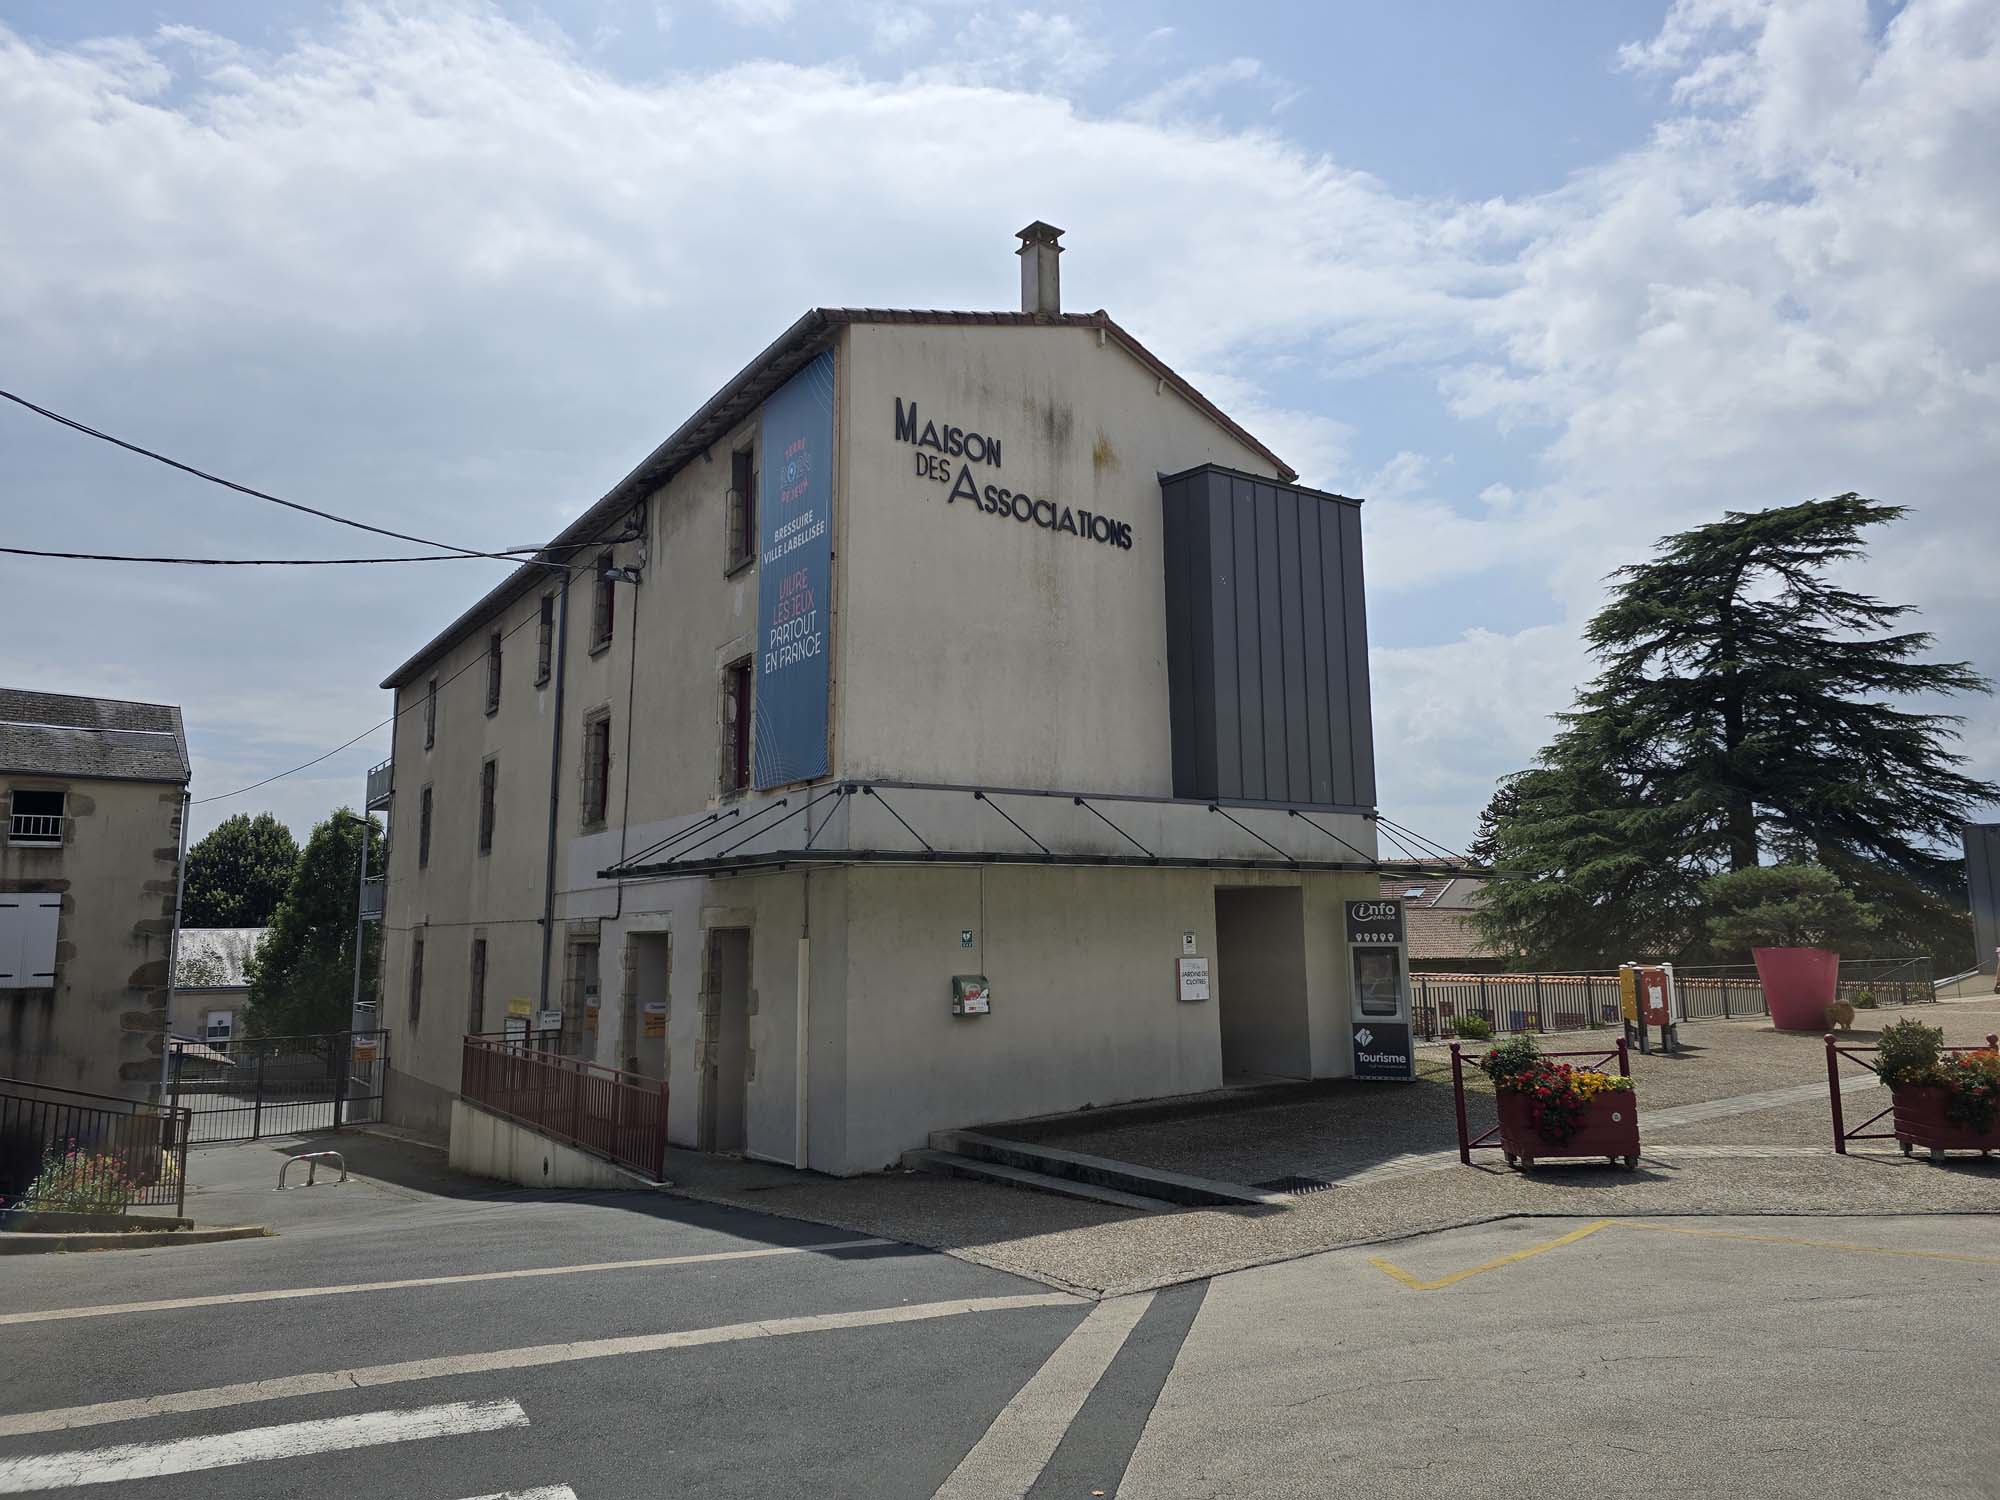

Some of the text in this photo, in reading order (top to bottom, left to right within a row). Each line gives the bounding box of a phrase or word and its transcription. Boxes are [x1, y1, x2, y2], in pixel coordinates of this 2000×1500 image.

[895, 397, 1001, 468] MAISON
[916, 452, 951, 483] DES
[774, 509, 813, 543] BRESSUIRE
[948, 464, 1132, 551] ASSOCIATIONS
[764, 519, 825, 565] VILLE LABELLISÉE
[780, 567, 809, 600] VIVRE
[773, 588, 816, 626] LES JEUX
[770, 610, 817, 649] PARTOUT
[765, 632, 821, 675] EN FRANCE
[1352, 902, 1395, 921] info
[1357, 1051, 1407, 1063] Tourisme
